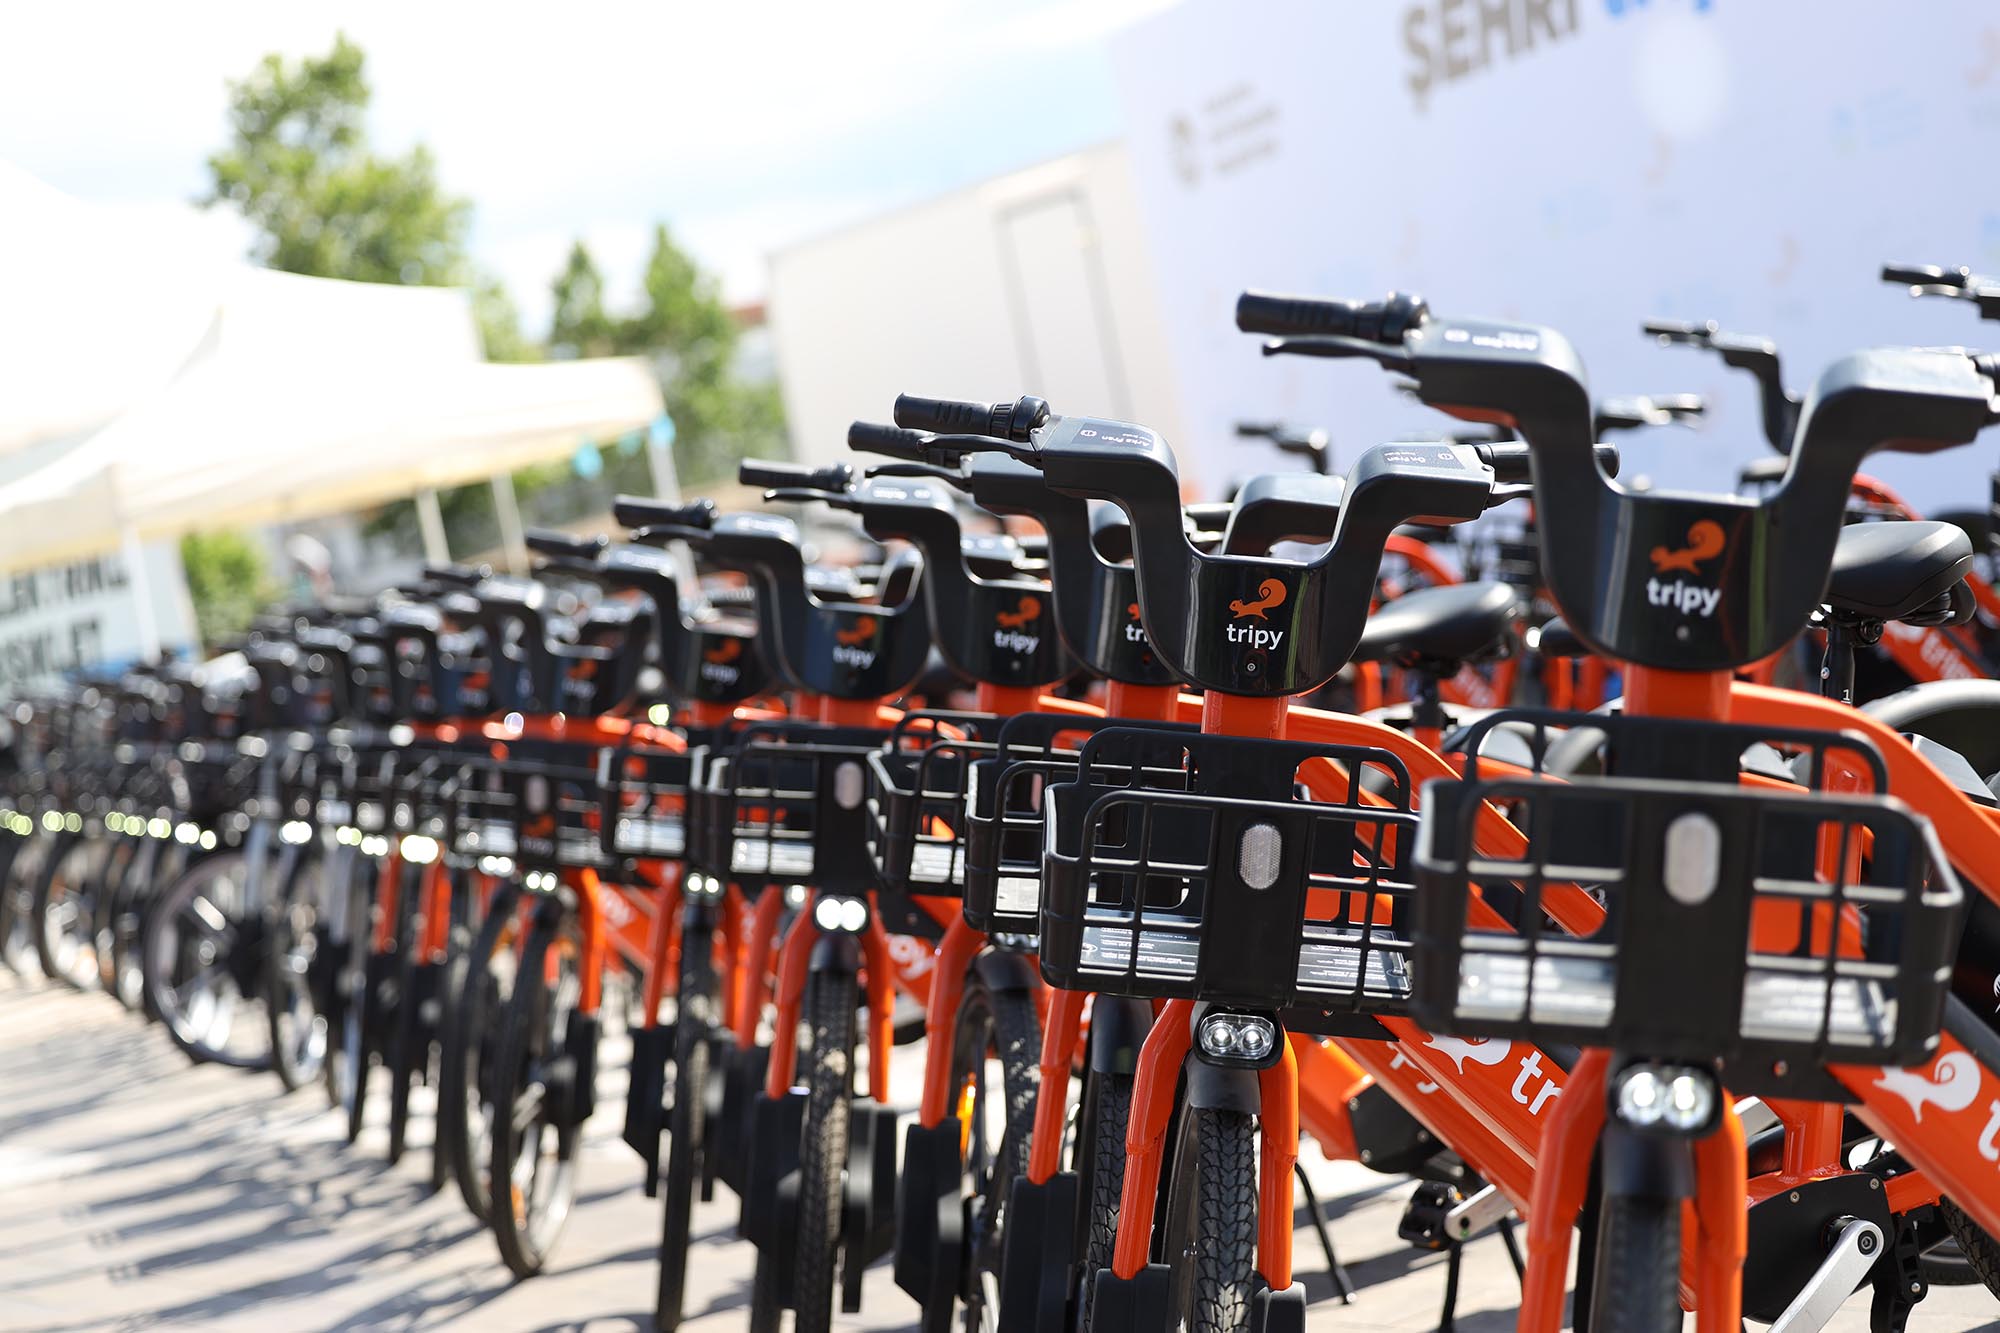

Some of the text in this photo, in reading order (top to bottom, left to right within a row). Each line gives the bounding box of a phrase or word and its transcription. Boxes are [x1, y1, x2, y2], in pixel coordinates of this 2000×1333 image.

[1646, 577, 1722, 617] tripy
[994, 630, 1040, 655] tripy
[1226, 623, 1284, 651] tripy
